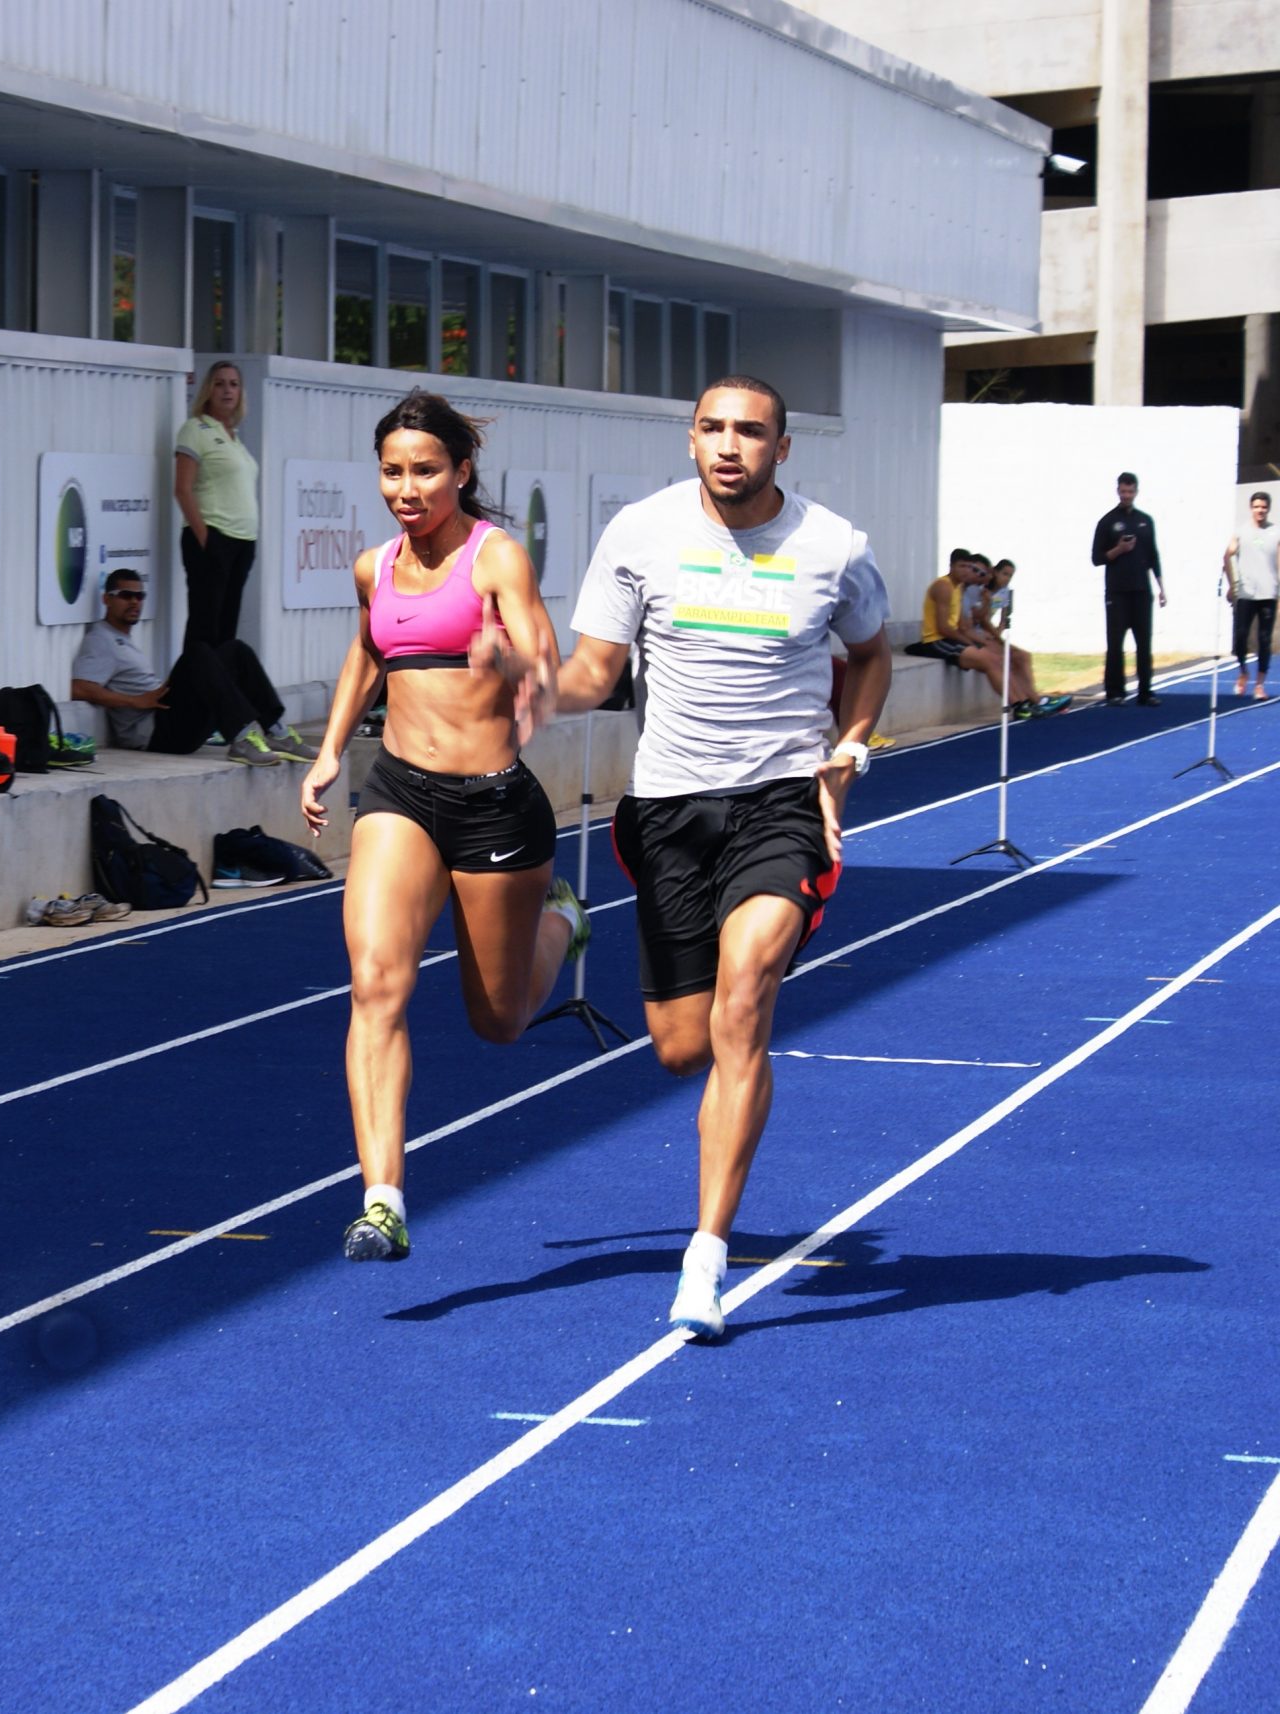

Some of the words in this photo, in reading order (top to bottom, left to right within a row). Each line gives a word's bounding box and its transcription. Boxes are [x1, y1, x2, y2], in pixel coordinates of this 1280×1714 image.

[676, 573, 792, 611] BRASIL
[678, 606, 752, 624] PARALYMPIC
[755, 613, 787, 626] TEAM
